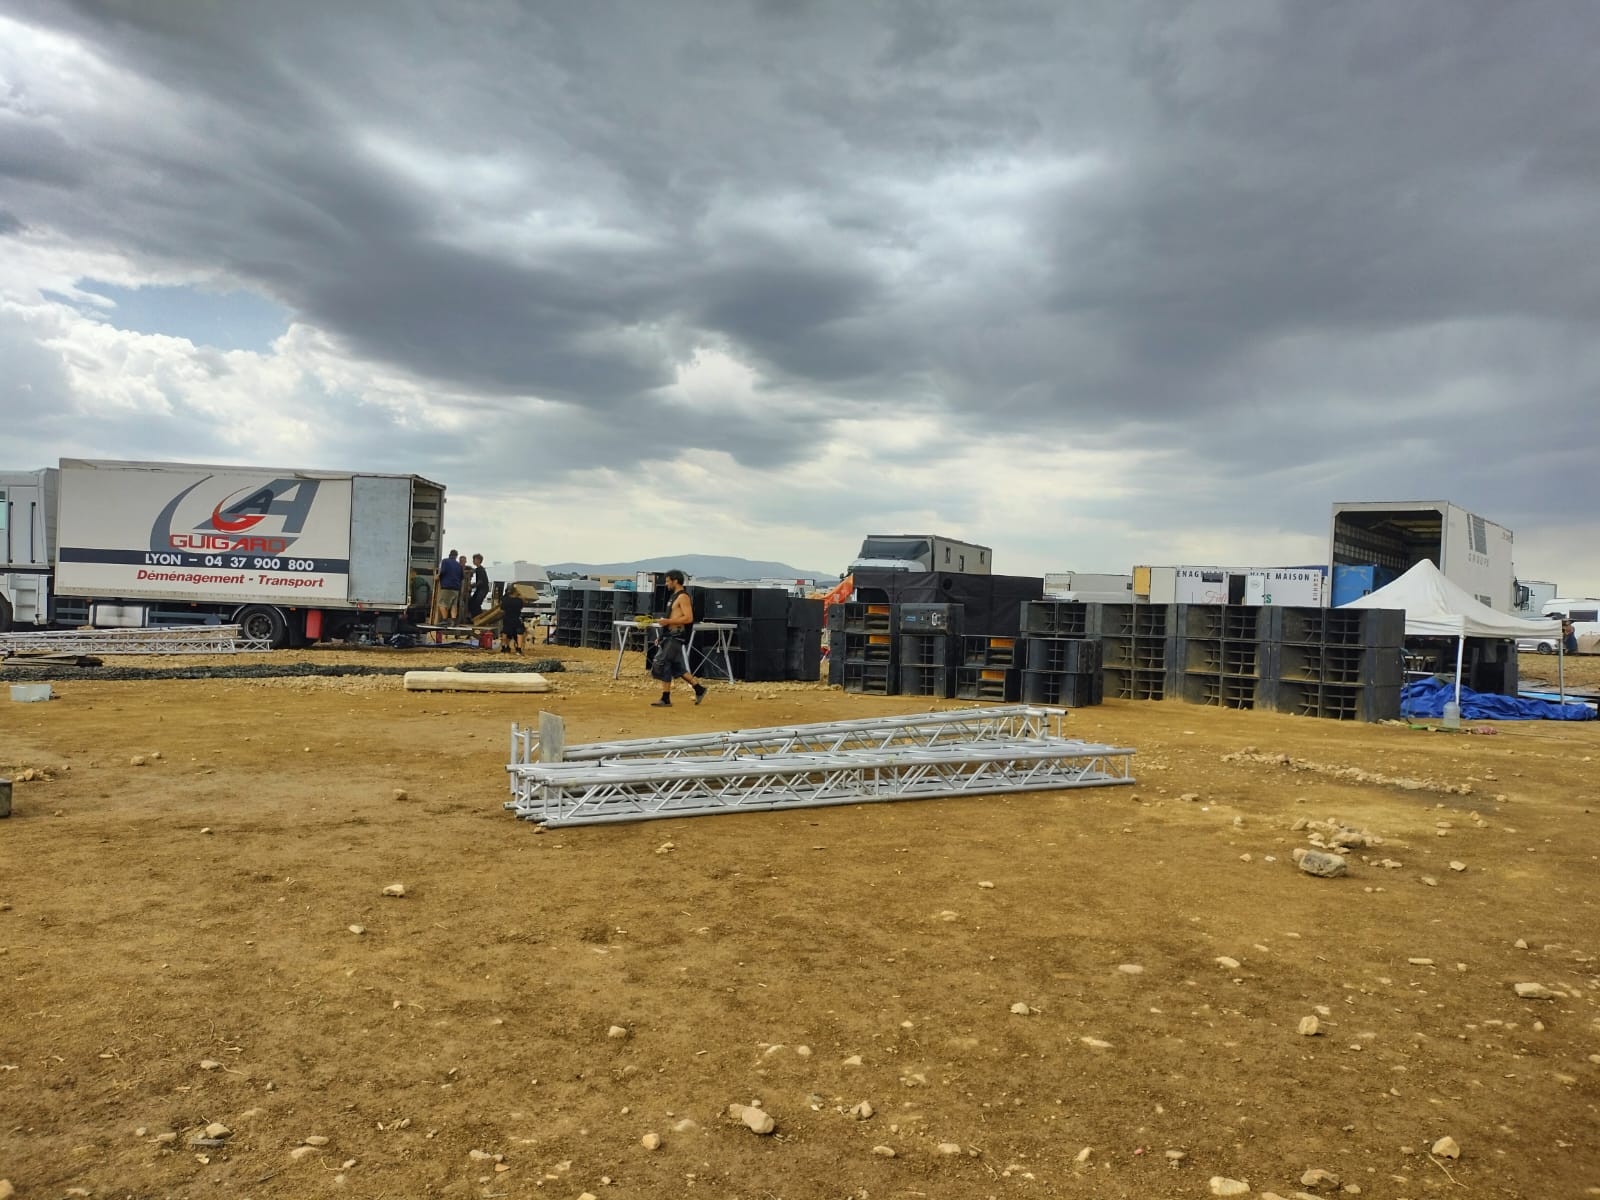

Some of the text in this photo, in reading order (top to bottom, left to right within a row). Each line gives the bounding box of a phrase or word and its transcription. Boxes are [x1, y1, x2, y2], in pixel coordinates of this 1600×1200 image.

[169, 534, 286, 553] GUIGARD
[145, 553, 182, 565] LYON
[205, 555, 222, 567] 04
[230, 557, 247, 568] 37
[254, 558, 281, 570] 900
[288, 559, 314, 571] 800
[137, 569, 244, 584] Déménagement
[258, 574, 325, 589] Transport
[1275, 572, 1310, 582] MAISON
